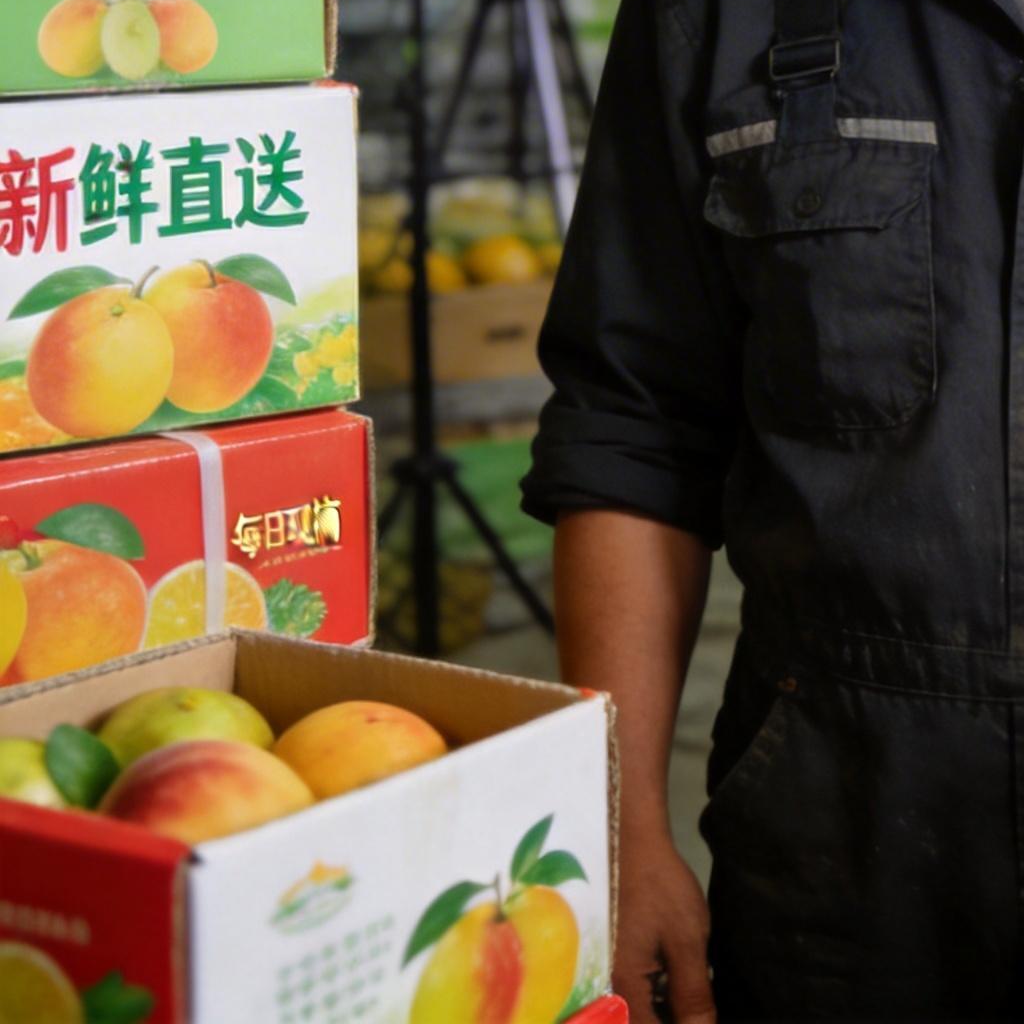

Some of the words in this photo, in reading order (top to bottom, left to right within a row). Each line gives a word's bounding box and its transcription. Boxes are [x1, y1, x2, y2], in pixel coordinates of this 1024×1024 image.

[0, 130, 310, 256] 新鲜直送
[230, 494, 342, 560] 每日现
